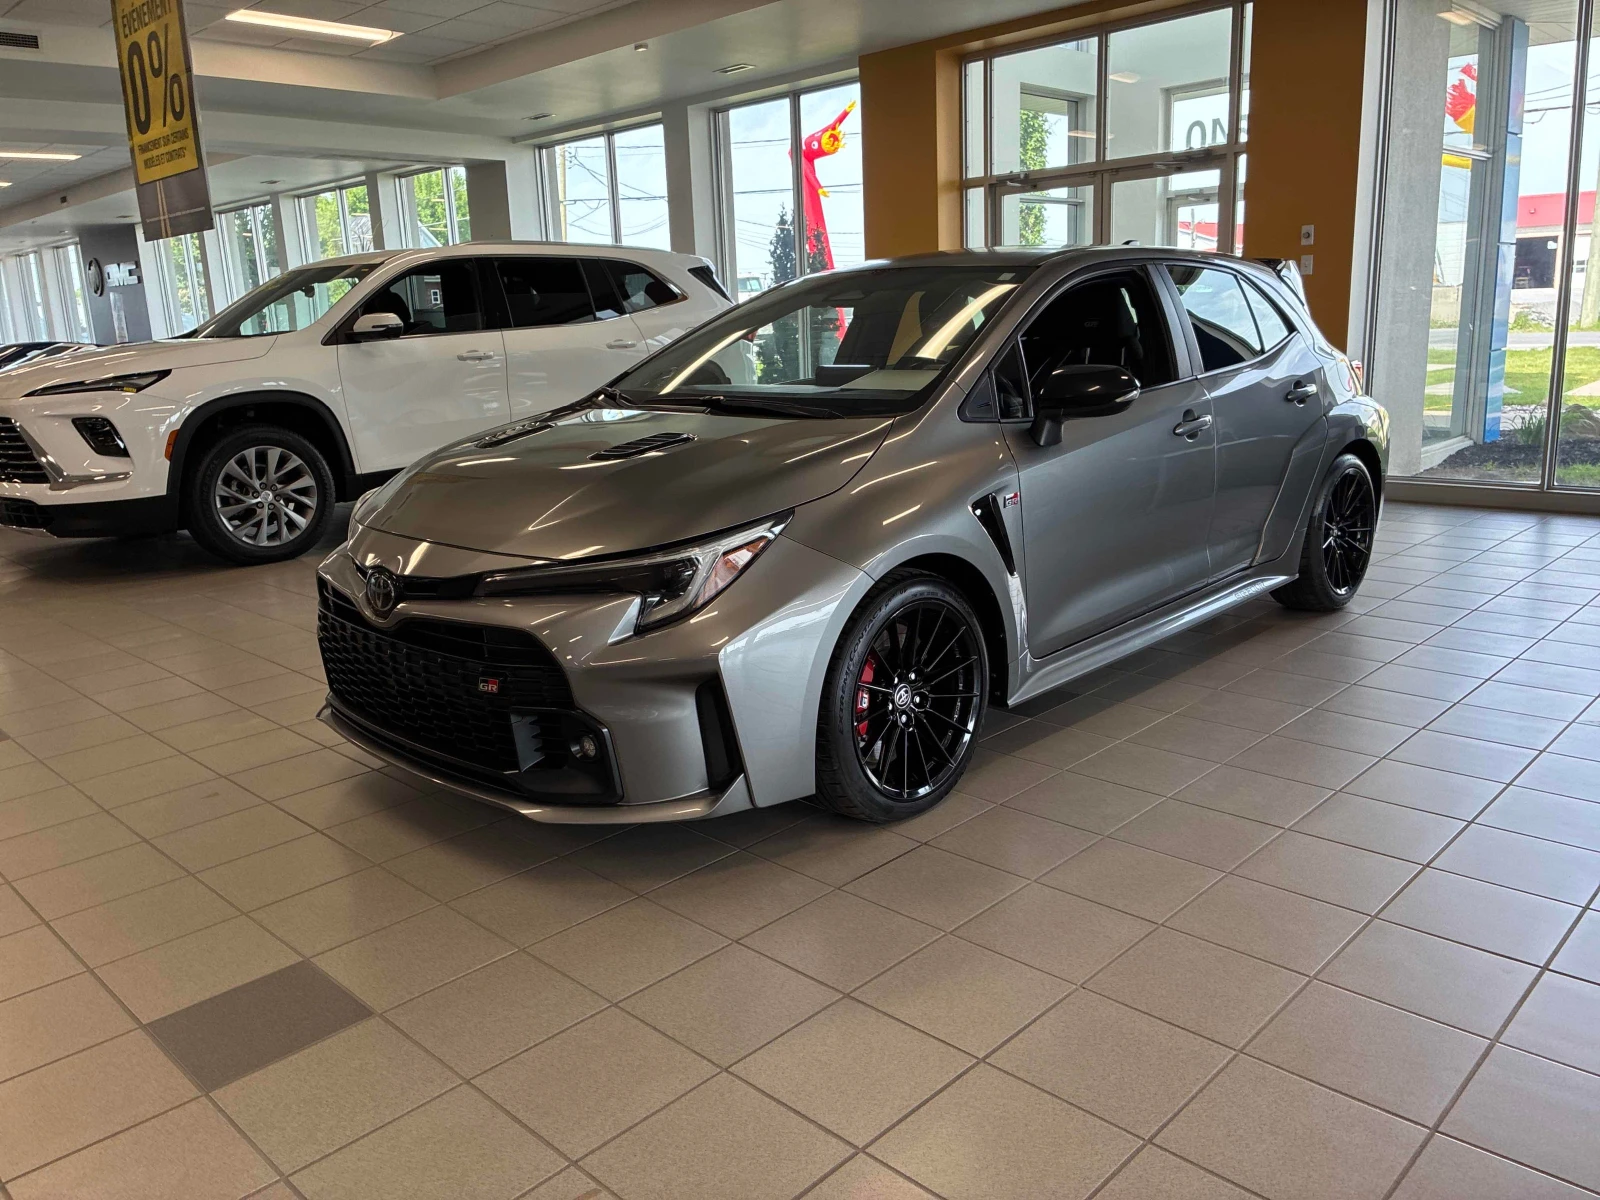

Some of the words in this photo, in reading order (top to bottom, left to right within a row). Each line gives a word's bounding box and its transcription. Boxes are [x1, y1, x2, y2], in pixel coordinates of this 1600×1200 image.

[161, 133, 171, 147] SUR
[104, 261, 139, 286] GMC
[480, 681, 498, 692] GR
